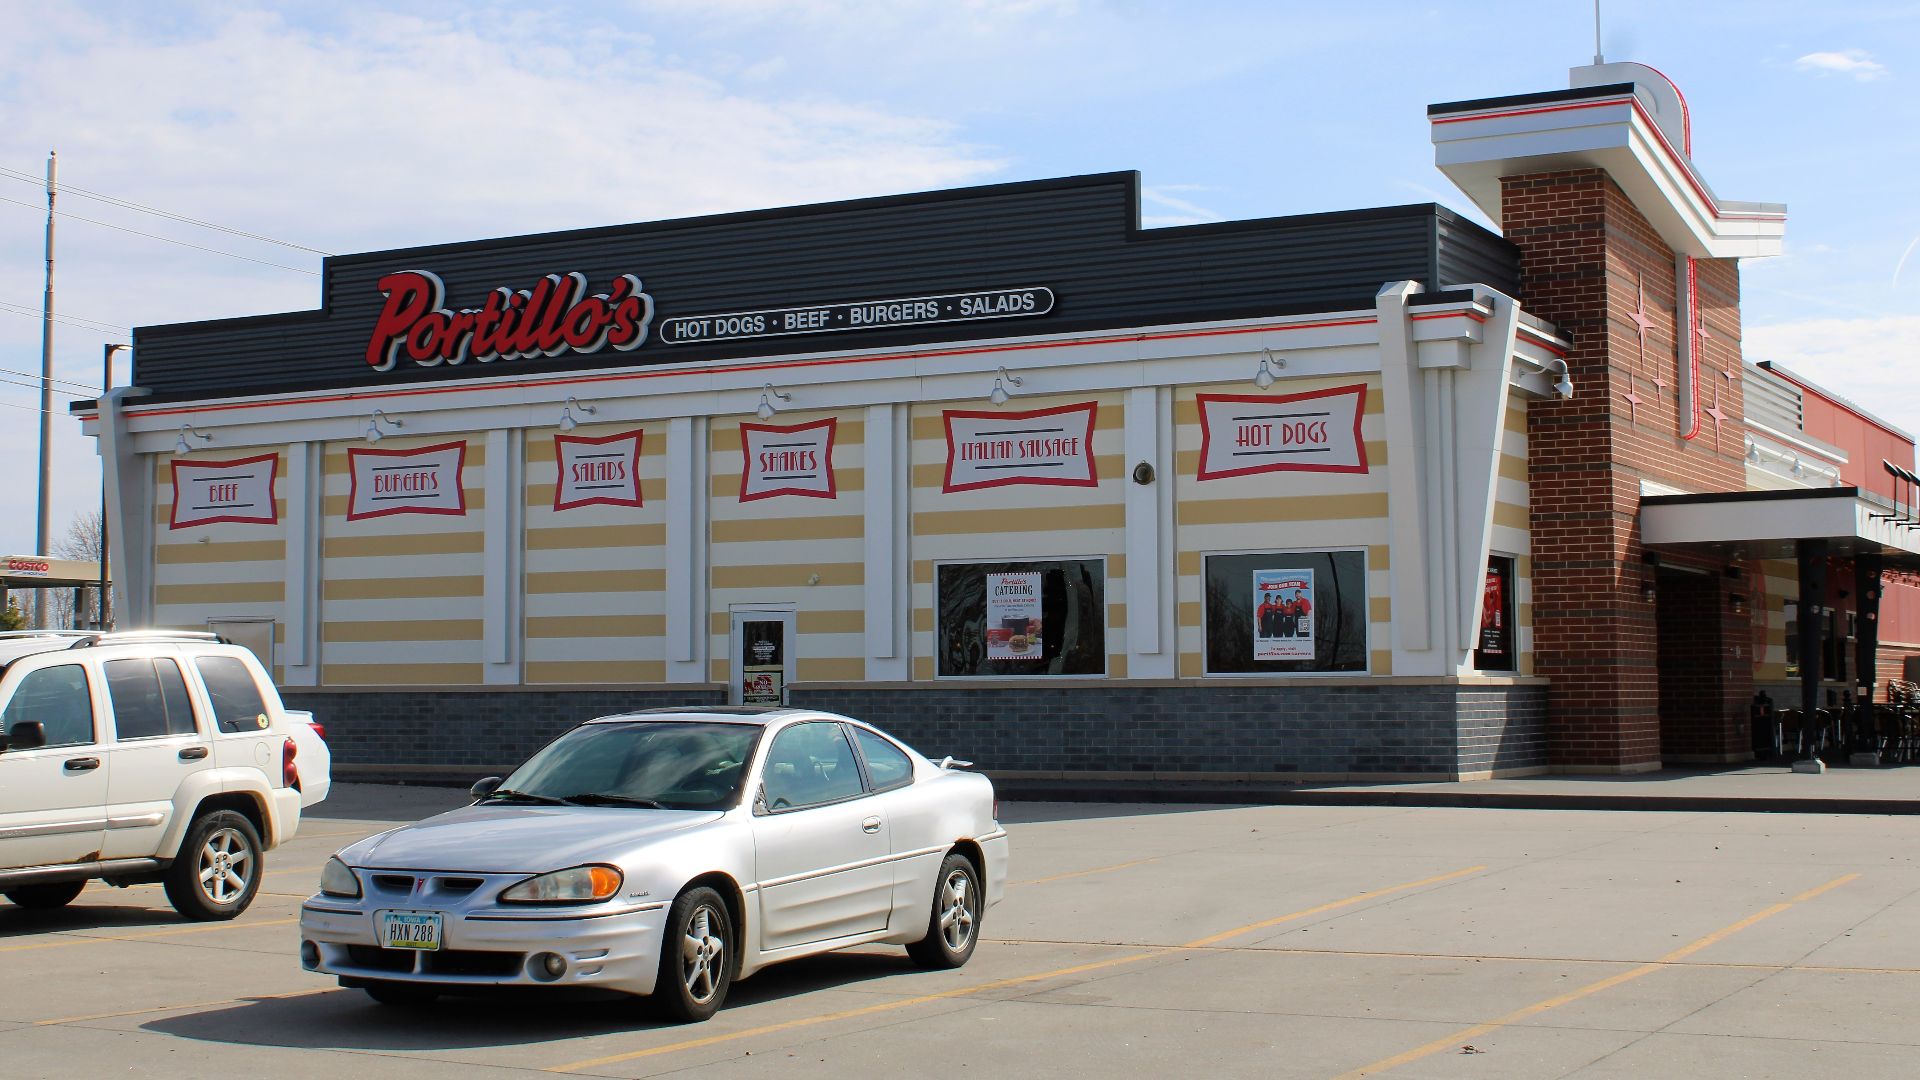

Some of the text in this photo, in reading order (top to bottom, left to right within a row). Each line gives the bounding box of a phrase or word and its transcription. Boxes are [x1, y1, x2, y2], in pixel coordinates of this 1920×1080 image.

[365, 270, 655, 371] Portillo's
[675, 292, 1036, 339] HOT DOGS BEEF BURGERS SALADS
[1236, 421, 1328, 448] HOT DOGS
[961, 437, 1079, 461] ITALIAN SAUSAGE
[572, 460, 626, 483] SALADS
[759, 450, 818, 473] SHAKES
[209, 483, 239, 502] BEEF
[374, 471, 439, 493] BURGERS
[8, 559, 49, 571] COSTCO
[995, 585, 1033, 596] CATERING
[390, 923, 434, 942] HXN 288
